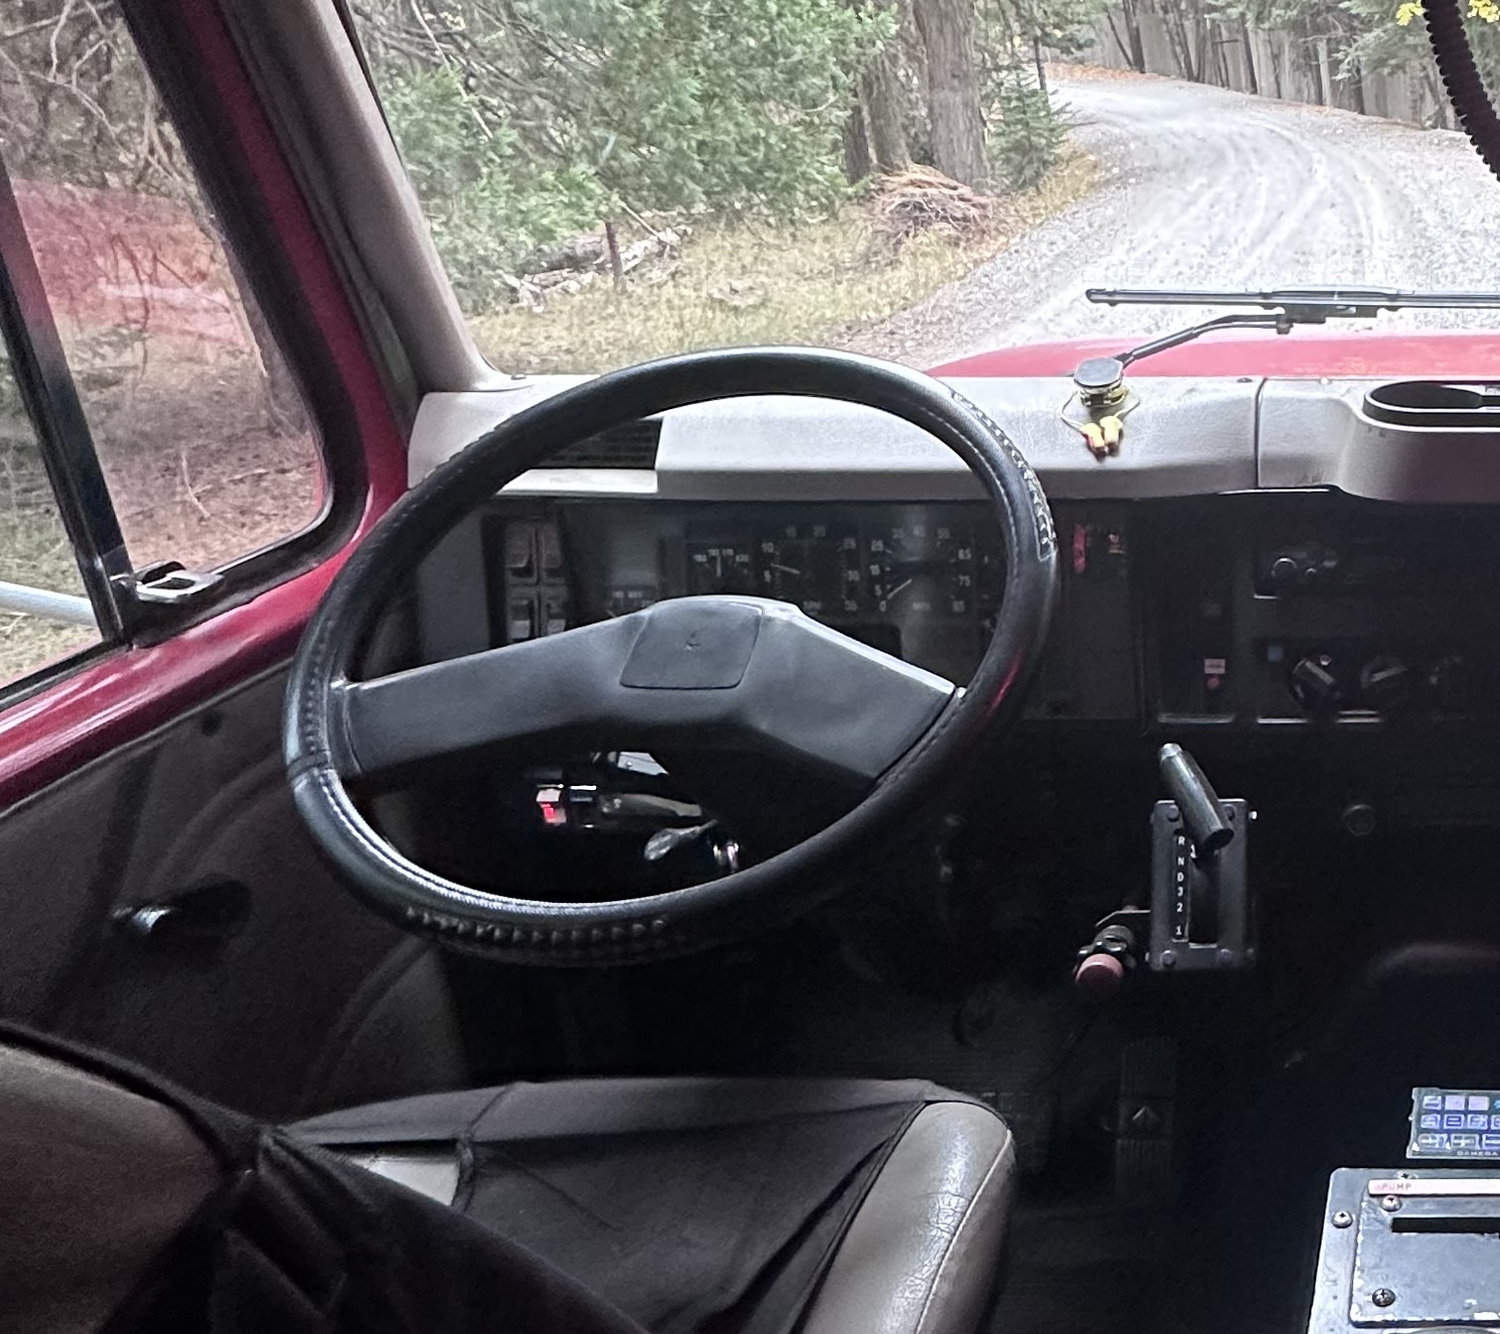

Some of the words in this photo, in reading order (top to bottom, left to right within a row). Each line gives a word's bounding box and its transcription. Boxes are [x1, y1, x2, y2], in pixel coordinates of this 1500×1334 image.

[1178, 836, 1185, 845] R
[1177, 857, 1185, 865] N
[1177, 872, 1184, 882] D
[1177, 887, 1184, 896] 3
[1176, 903, 1183, 912] 2
[1175, 926, 1182, 935] 1
[1381, 1182, 1412, 1191] PUMP
